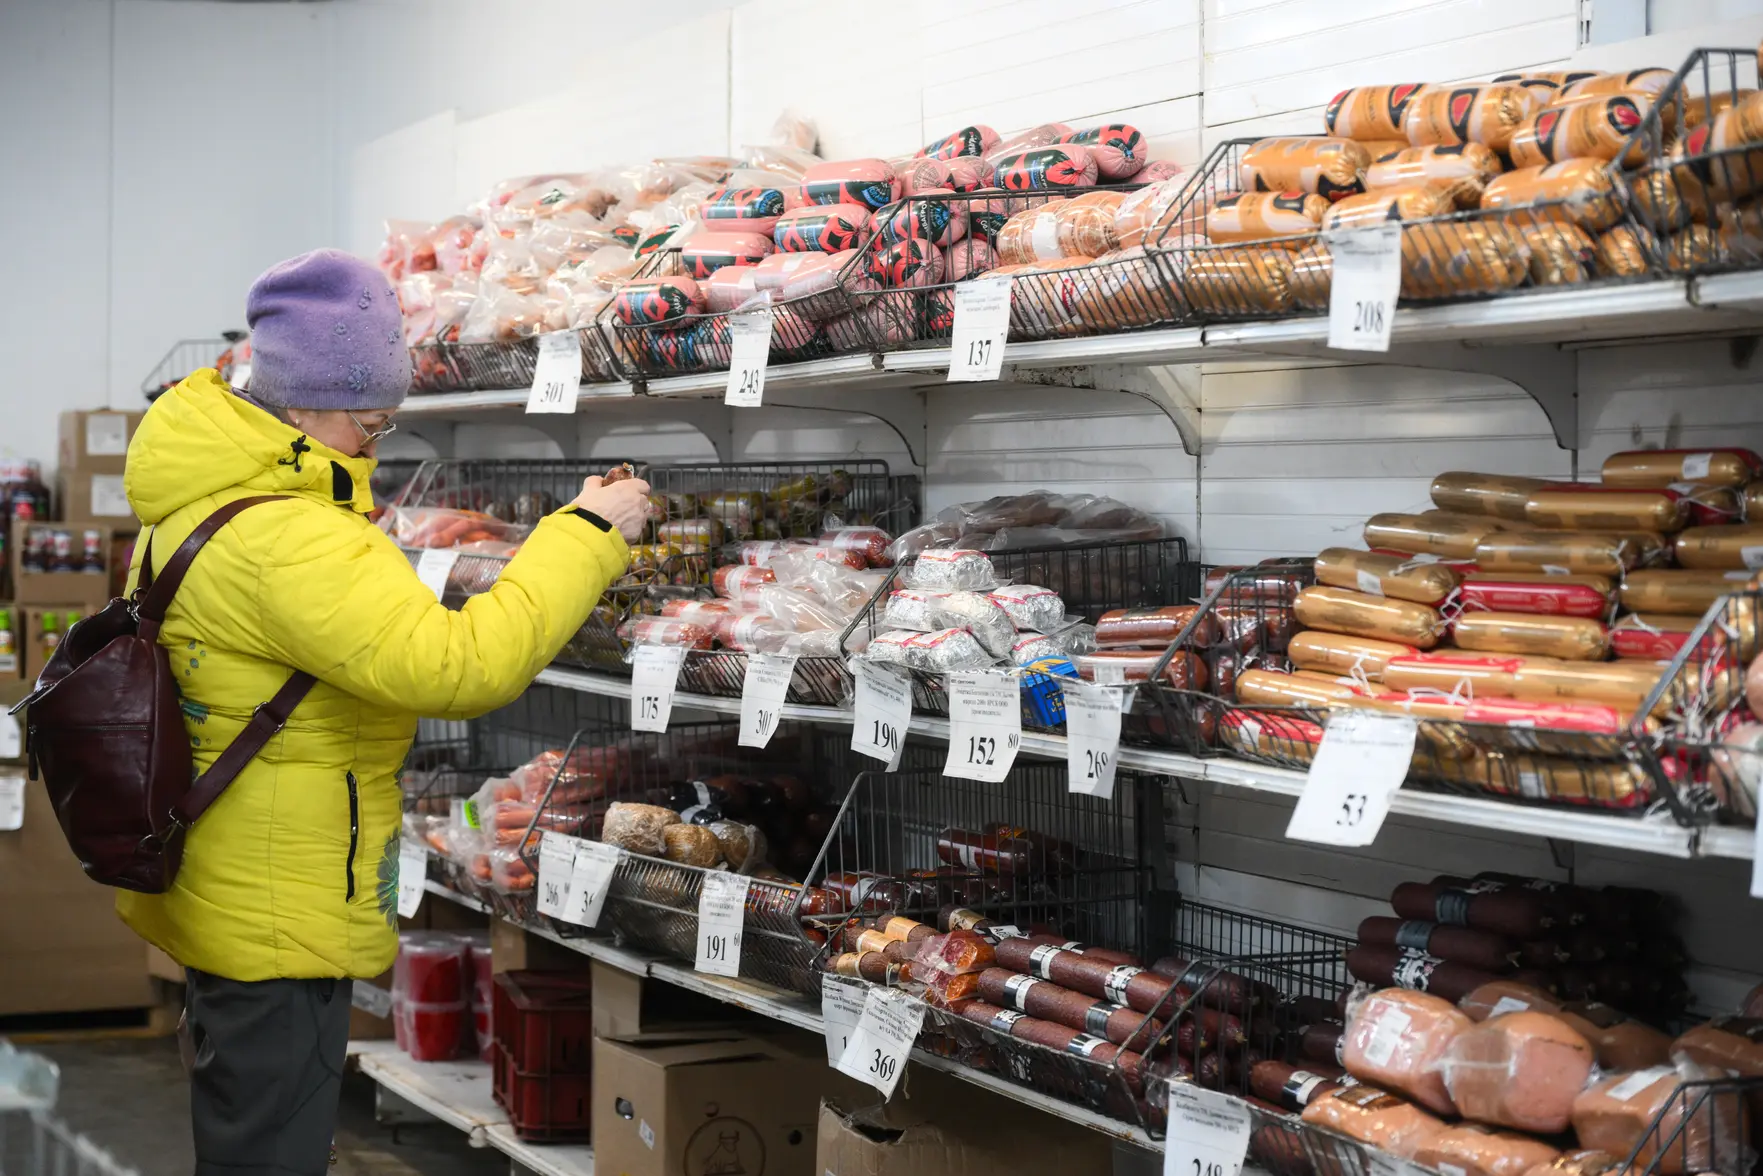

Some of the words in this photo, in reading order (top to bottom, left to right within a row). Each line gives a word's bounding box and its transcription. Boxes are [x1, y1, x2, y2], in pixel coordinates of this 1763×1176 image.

[1354, 301, 1384, 333] 208
[968, 340, 992, 366] 137
[540, 382, 564, 403] 301
[739, 369, 760, 395] 243
[641, 696, 659, 719] 175
[756, 709, 773, 736] 301
[873, 720, 898, 752] 190
[967, 736, 996, 766] 152
[1007, 733, 1019, 749] 80
[1336, 794, 1367, 826] 53
[706, 935, 726, 961] 191
[869, 1048, 896, 1081] 369
